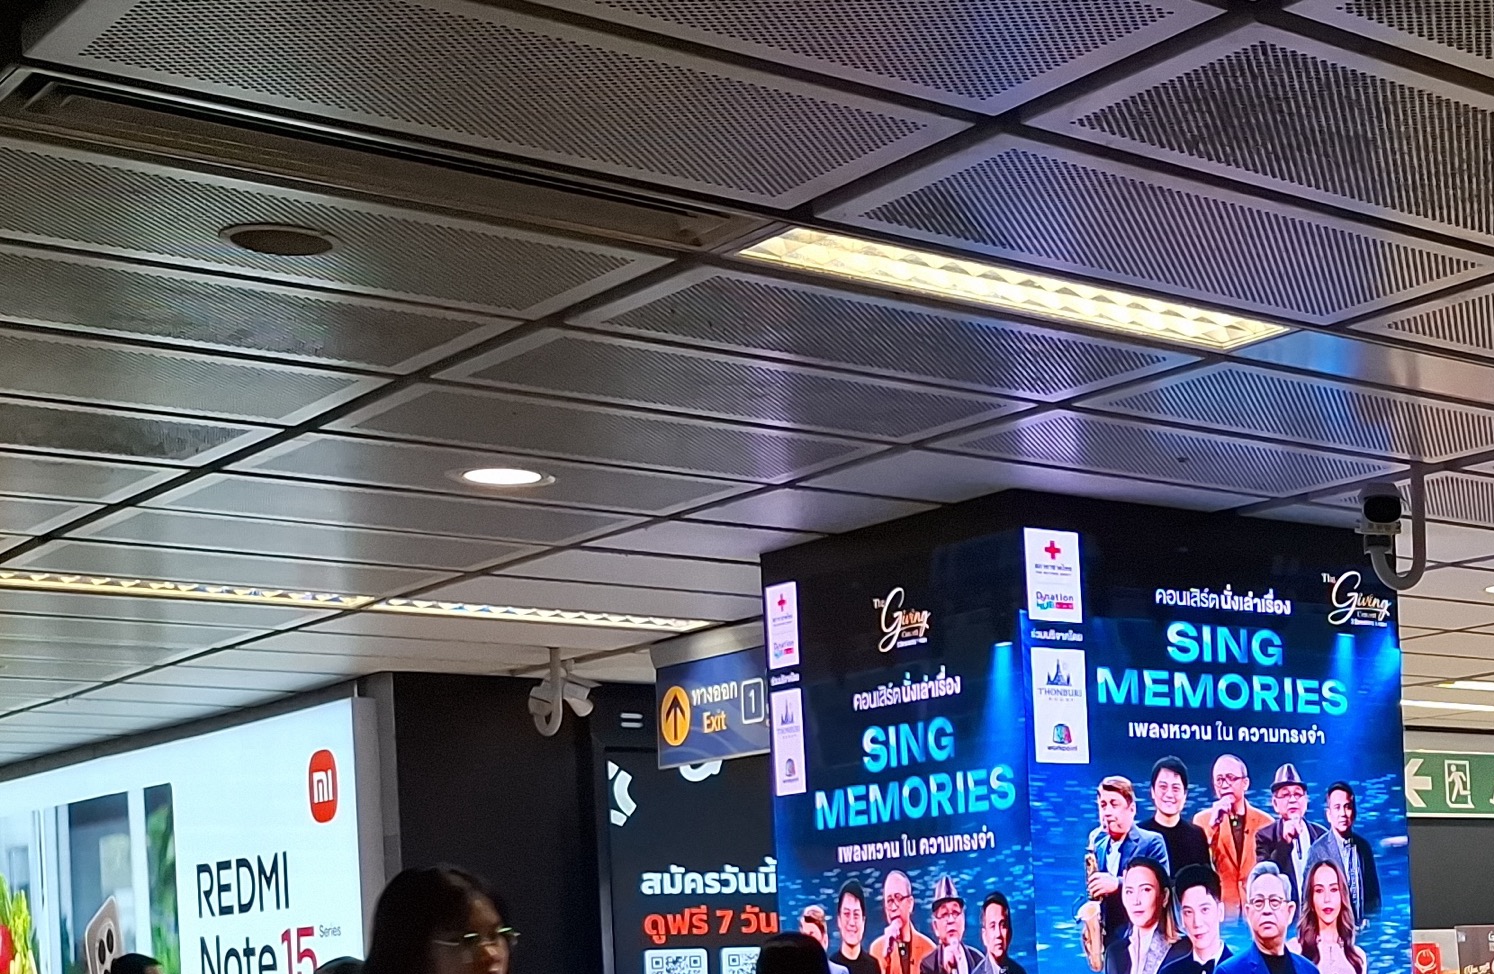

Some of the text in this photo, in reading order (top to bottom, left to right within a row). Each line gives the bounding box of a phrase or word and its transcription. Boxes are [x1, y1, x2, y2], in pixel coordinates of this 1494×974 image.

[1327, 570, 1392, 626] Giving
[878, 587, 931, 653] Giving
[1166, 620, 1283, 667] SING
[692, 681, 738, 706] ทางออก
[748, 688, 756, 714] 1
[1096, 666, 1349, 716] MEMORIES
[703, 710, 728, 734] Exit
[1128, 721, 1326, 744] เพลงหวาน ใน ความทรงจำ
[862, 716, 955, 773] SING
[814, 764, 1017, 830] MEMORIES
[837, 825, 996, 863] เพลงหวาน ใน ความทรงจำ
[196, 851, 290, 919] REDMI
[640, 856, 778, 895] สมัครวันนี้
[319, 924, 341, 938] Series
[643, 904, 779, 944] ดูฟรี 7 วัน
